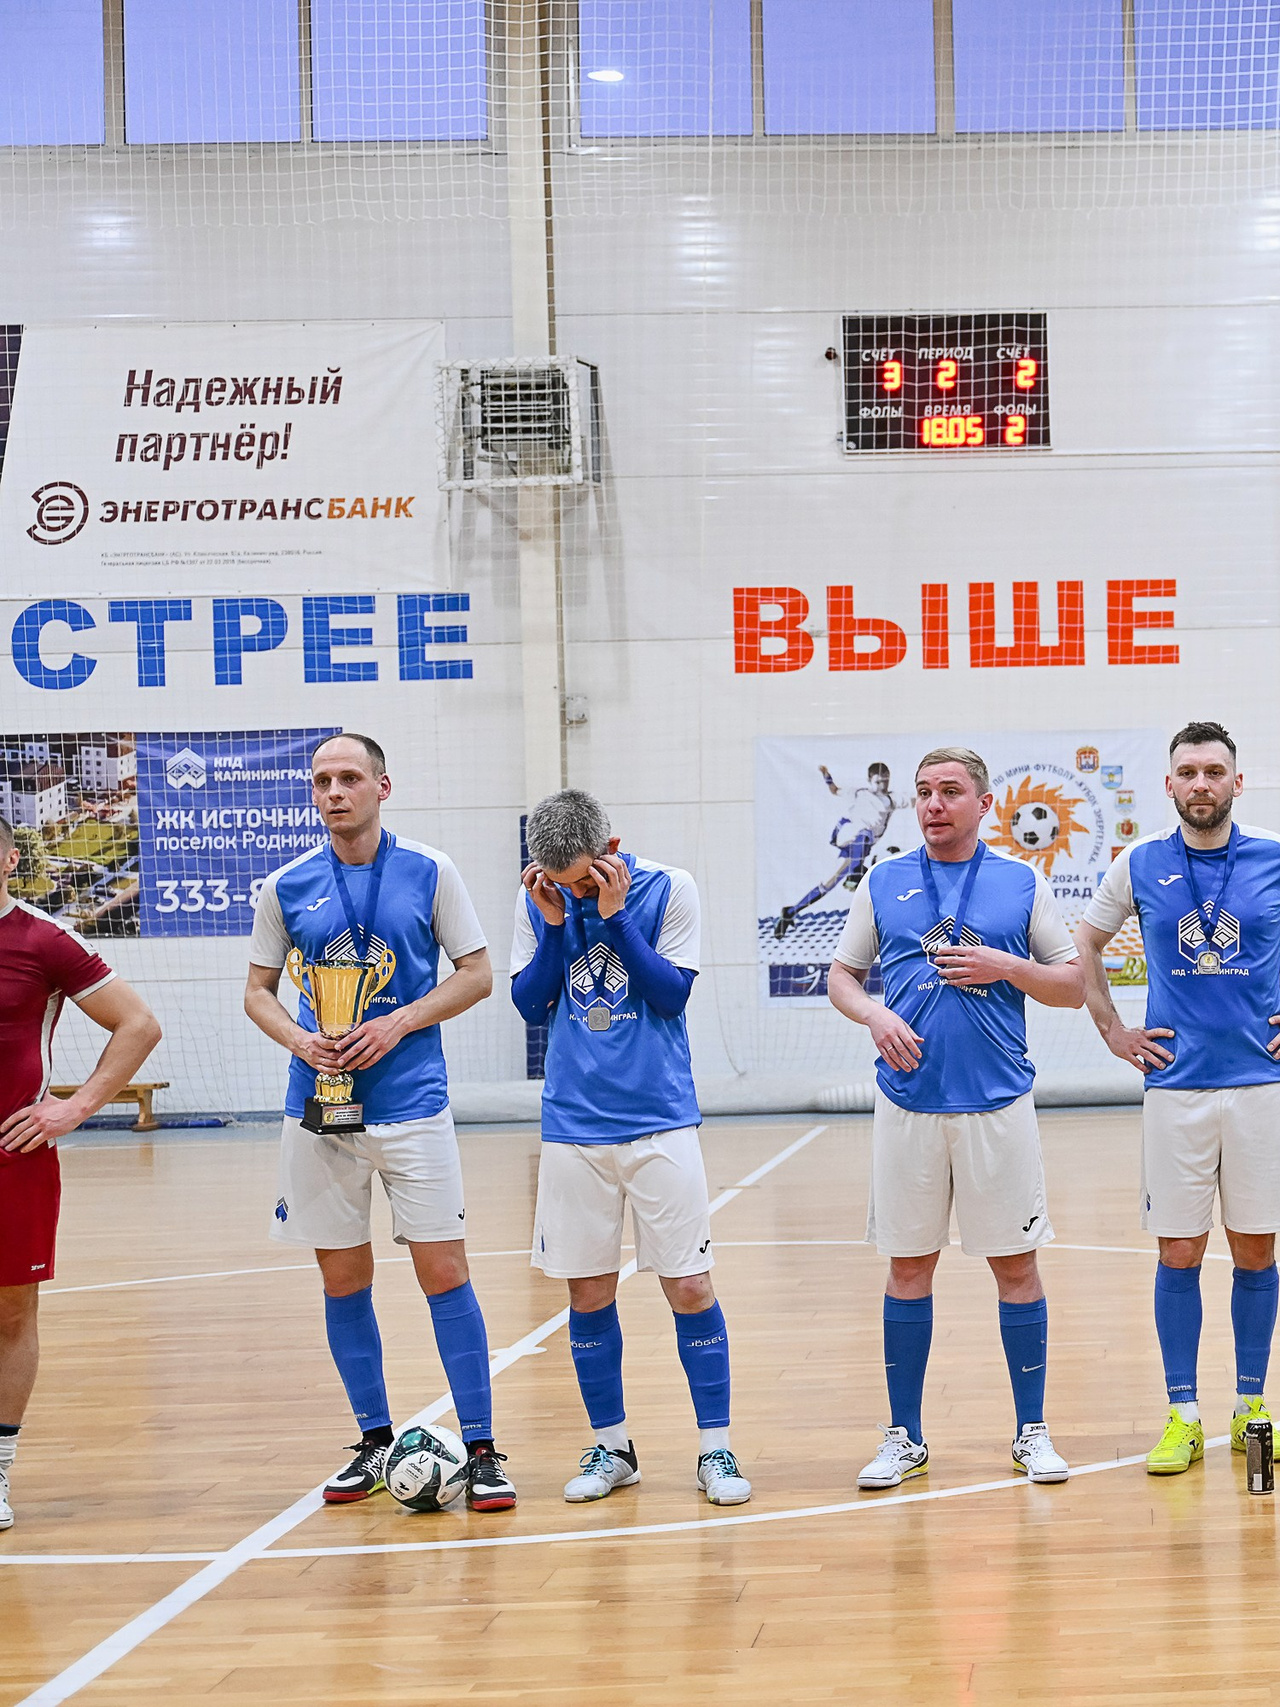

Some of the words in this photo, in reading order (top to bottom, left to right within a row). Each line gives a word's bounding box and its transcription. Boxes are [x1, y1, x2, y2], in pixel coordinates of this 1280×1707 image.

[918, 346, 974, 360] ПЕРИОД
[883, 360, 902, 391] 3
[937, 360, 957, 389] 2
[1016, 358, 1036, 388] 2
[123, 367, 343, 408] Надежный
[859, 405, 902, 418] ФОЛЫ
[924, 404, 972, 417] ВРЕМЯ
[993, 403, 1036, 416] ФОЛЫ
[1005, 415, 1025, 445] 2
[115, 422, 290, 470] партнёр!
[99, 496, 416, 523] ЭНЕРГОТРАНСБАНК
[733, 579, 1180, 673] ВЫШЕ
[11, 593, 473, 690] СТРЕЕ
[214, 756, 243, 769] КПД
[214, 769, 312, 783] КАЛИНИНГРАД
[992, 774, 1005, 788] ПО
[156, 810, 195, 830] ЖК
[156, 836, 237, 851] поселок
[242, 831, 329, 851] Родники
[1052, 874, 1080, 883] 2024
[1050, 888, 1093, 901] ГРАД
[1171, 969, 1186, 977] КПД
[917, 981, 934, 991] КПД
[570, 1340, 602, 1349] ÖGEL
[687, 1336, 725, 1347] JÖGEL
